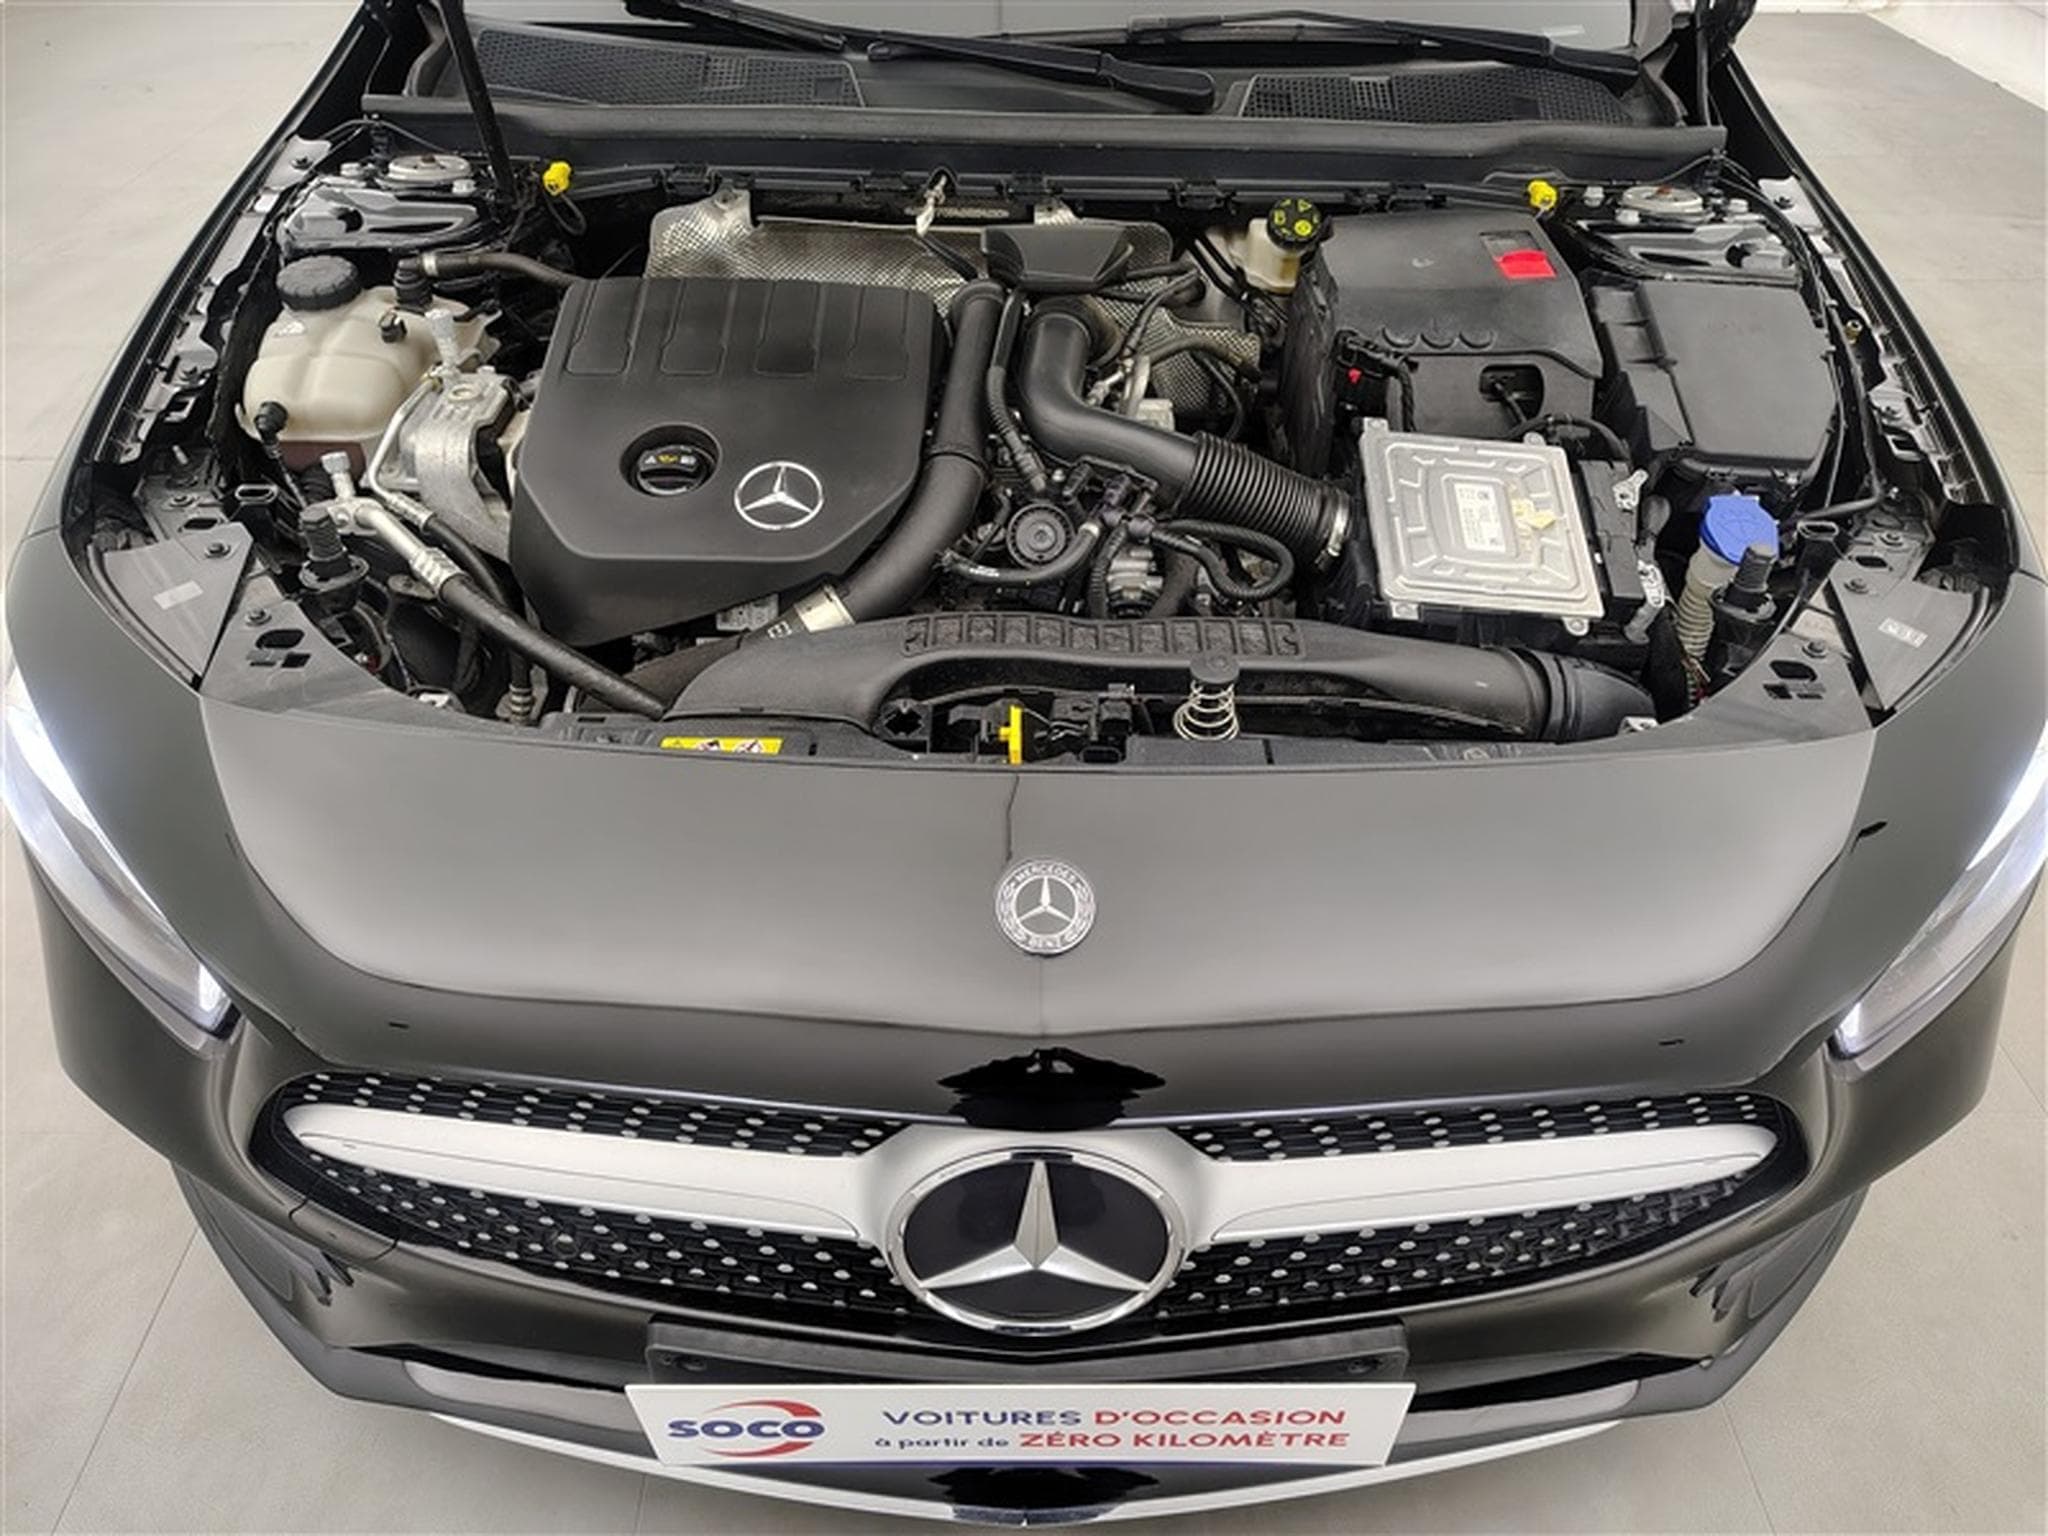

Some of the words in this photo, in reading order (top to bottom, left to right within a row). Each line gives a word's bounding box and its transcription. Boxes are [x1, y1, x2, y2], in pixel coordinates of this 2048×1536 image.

[882, 1410, 1081, 1425] VOITURES
[1094, 1409, 1346, 1426] D'OCCASION
[668, 1420, 825, 1438] SOCO
[898, 1437, 968, 1449] partir
[977, 1436, 1009, 1447] de
[1019, 1431, 1122, 1448] ZÉRO
[1133, 1431, 1350, 1448] KILOMÈTRE
